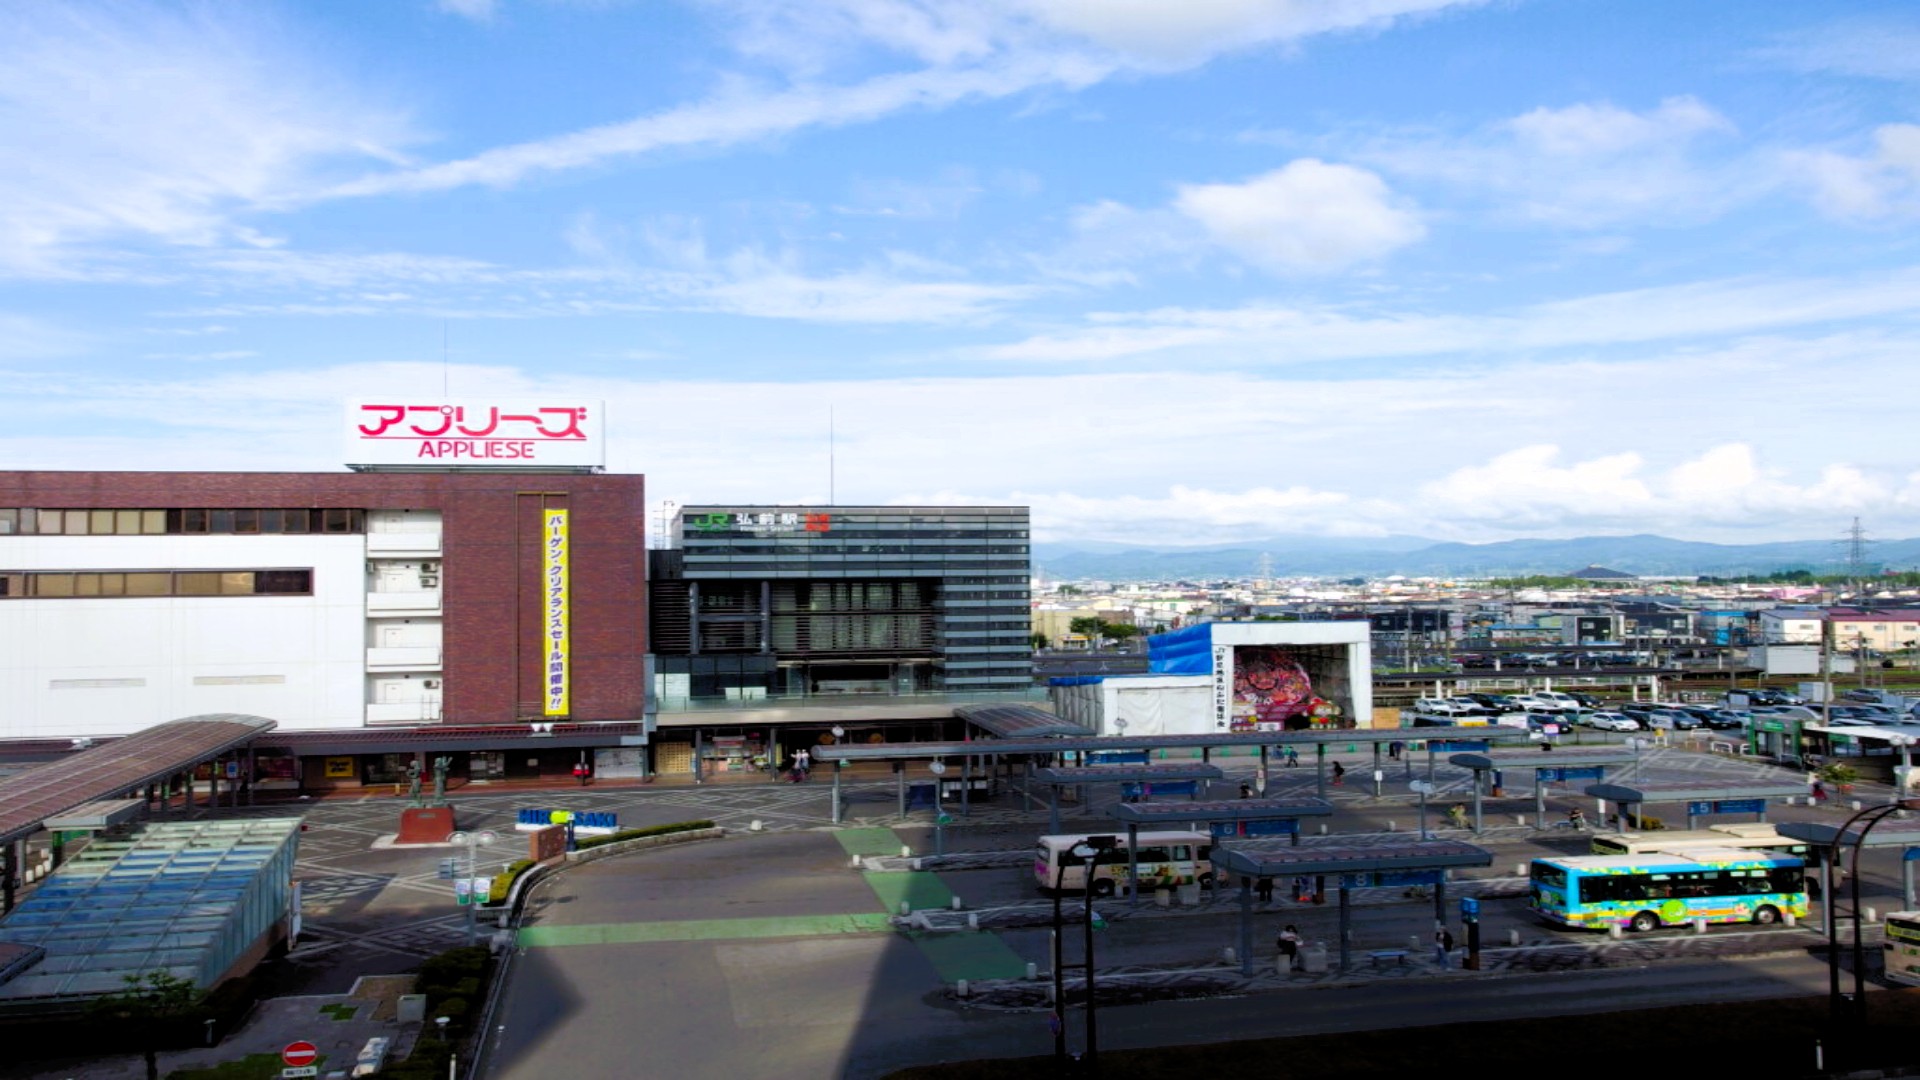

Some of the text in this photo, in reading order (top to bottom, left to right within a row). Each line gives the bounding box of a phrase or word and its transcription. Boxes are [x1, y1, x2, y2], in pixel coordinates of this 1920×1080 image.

[358, 404, 587, 437] アプリーズ
[418, 441, 535, 458] APPLIESE
[694, 513, 728, 527] JR
[736, 512, 798, 525] 弘前駅
[1700, 802, 1709, 813] 5
[1355, 873, 1366, 887] 8
